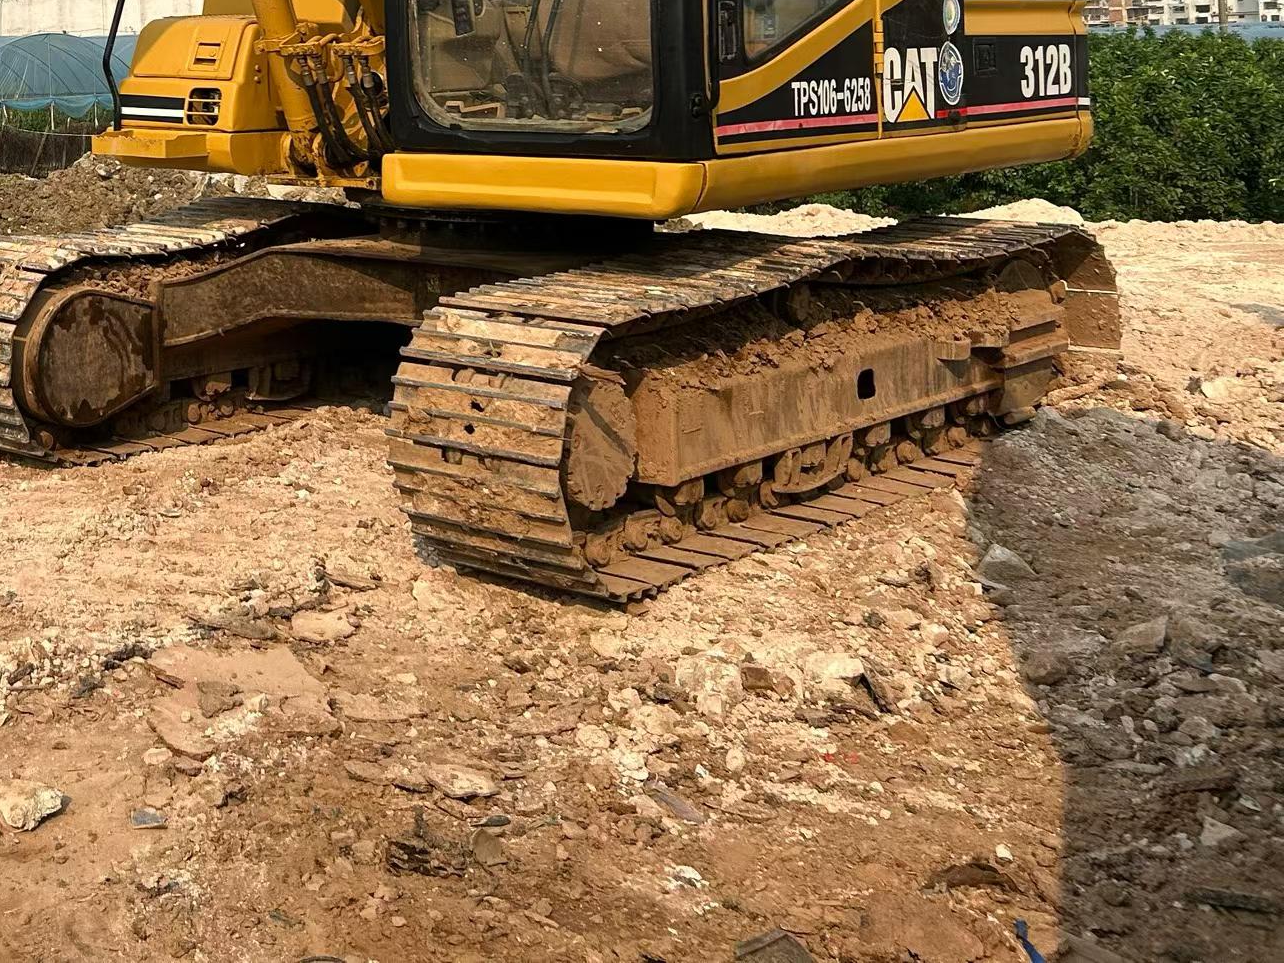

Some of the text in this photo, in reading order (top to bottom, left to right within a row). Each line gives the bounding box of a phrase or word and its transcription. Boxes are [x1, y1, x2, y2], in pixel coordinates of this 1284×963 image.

[791, 77, 871, 116] TPS106-6258
[883, 47, 937, 123] CAT
[1020, 44, 1072, 98] 312B
